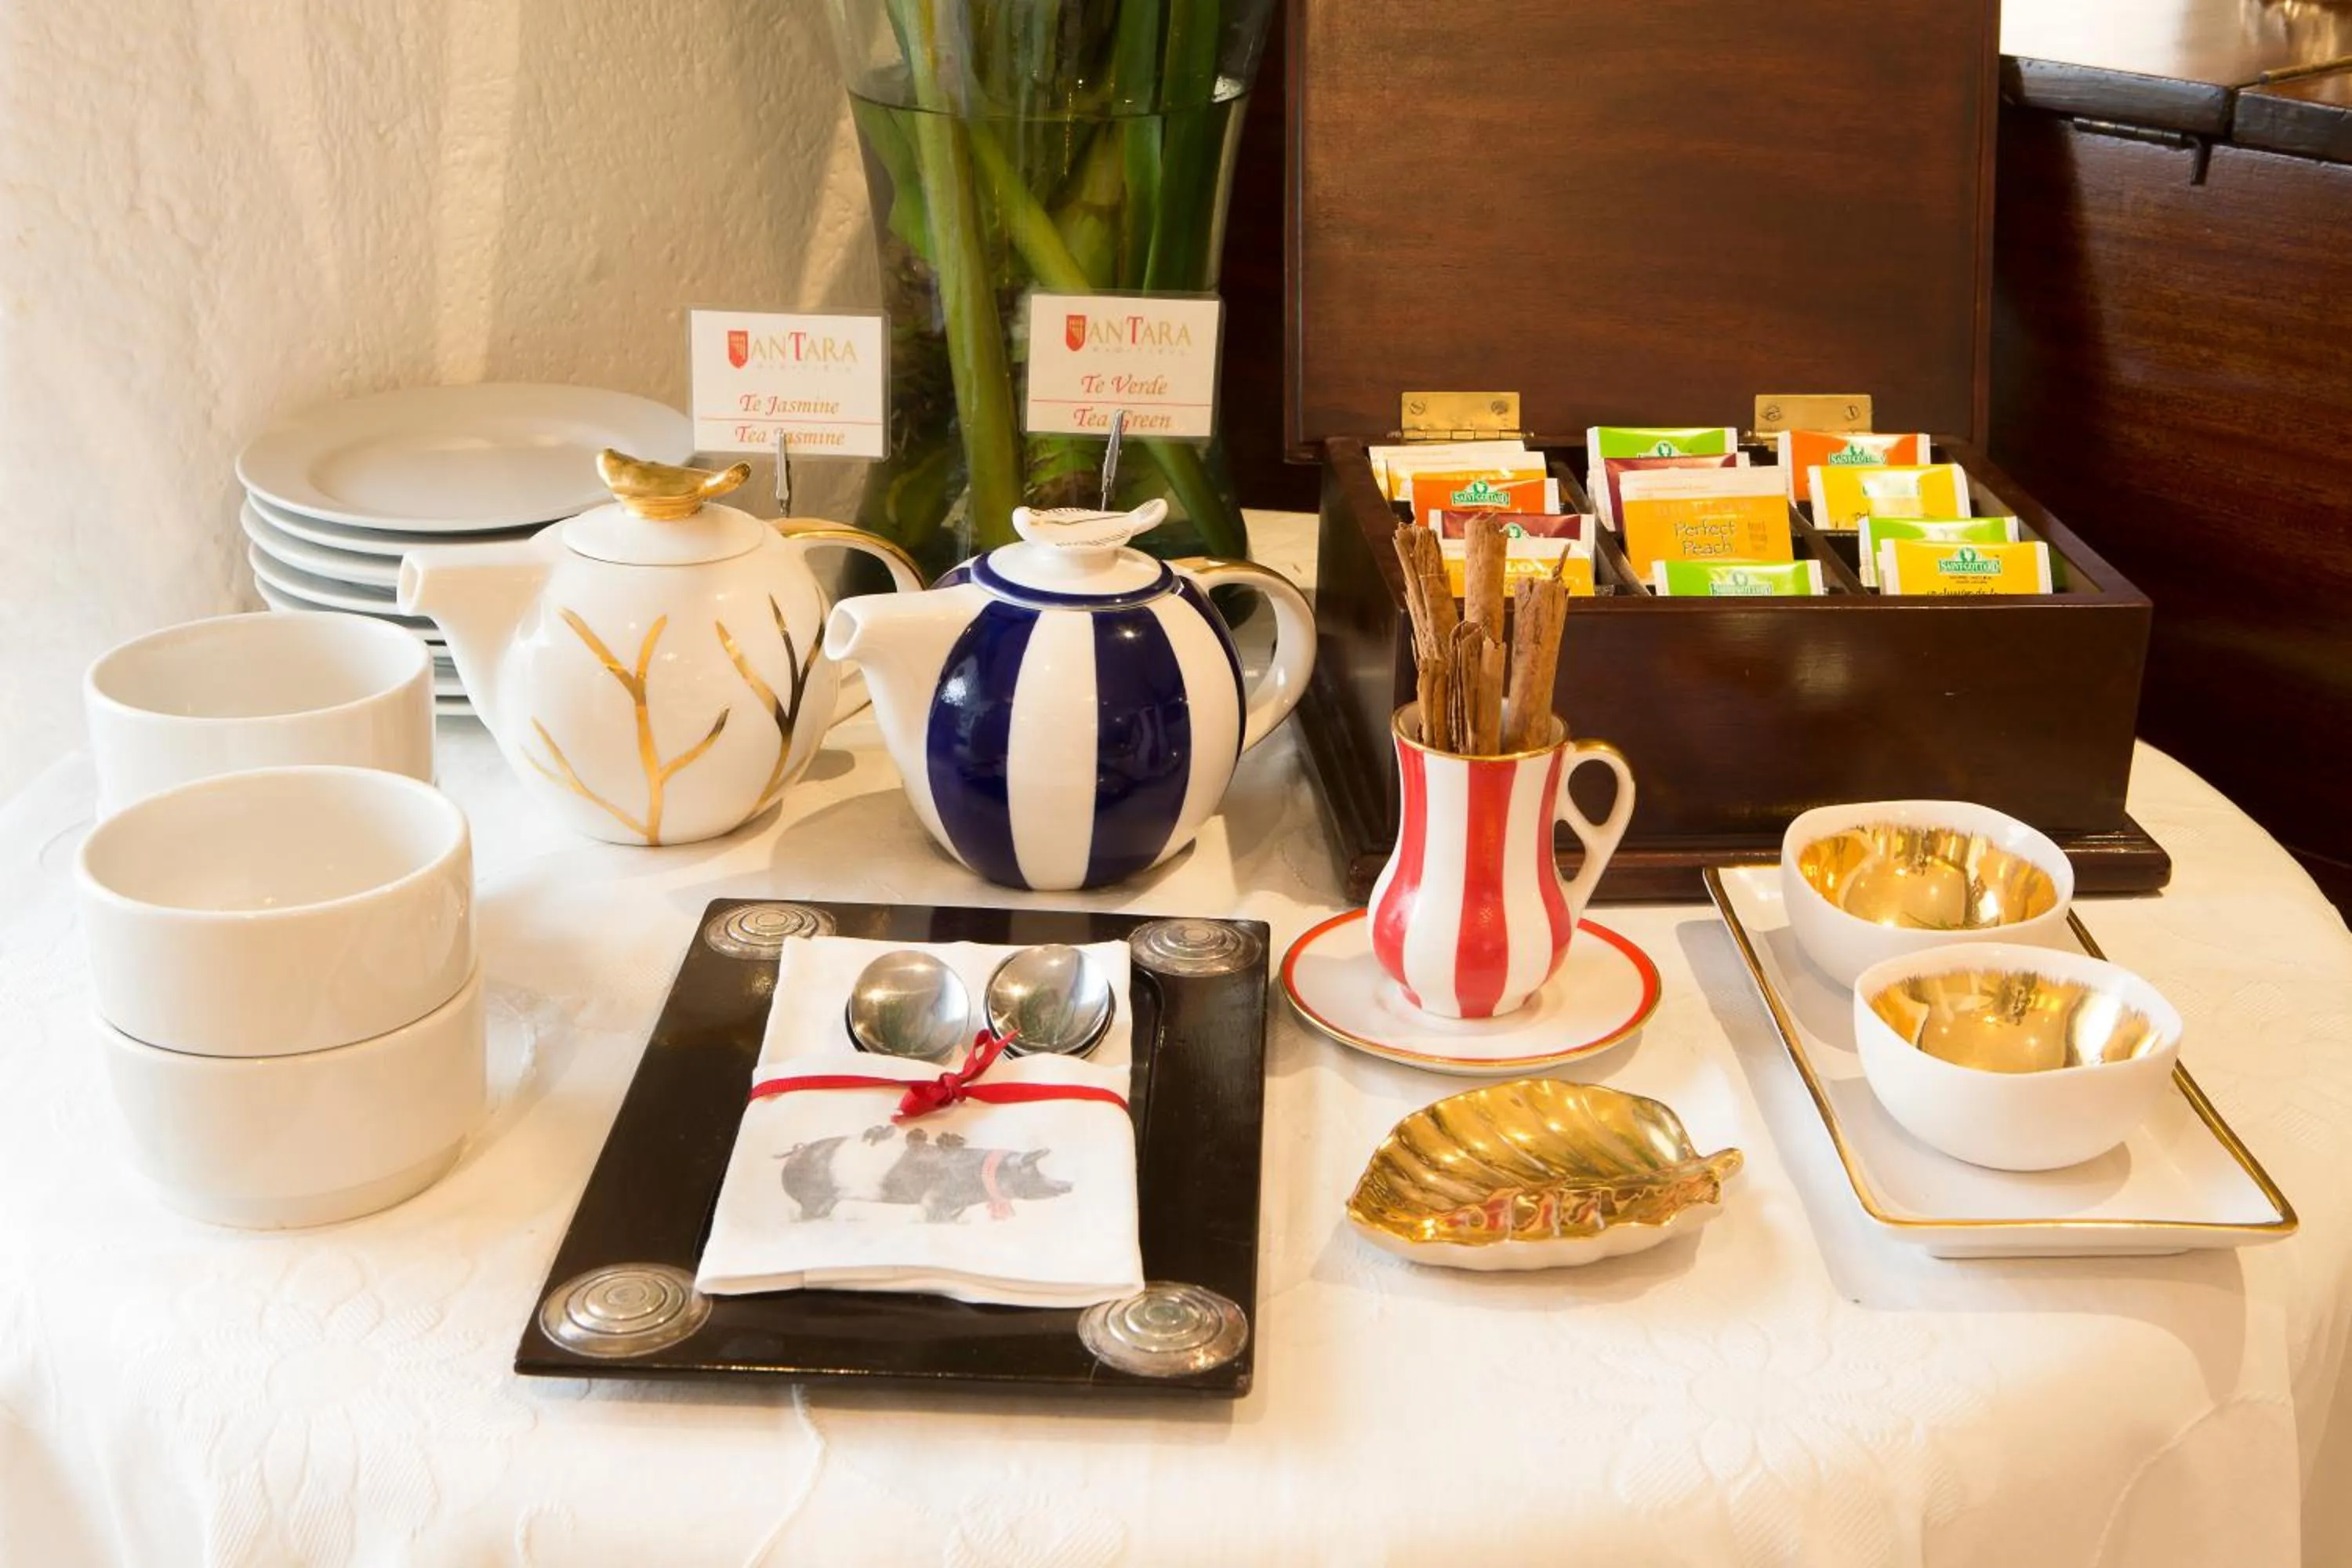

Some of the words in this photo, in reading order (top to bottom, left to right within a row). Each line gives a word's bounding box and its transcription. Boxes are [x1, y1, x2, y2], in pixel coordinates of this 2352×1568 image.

[1081, 375, 1105, 394] Te
[1111, 373, 1167, 395] Verde
[739, 394, 760, 412] Te
[765, 395, 839, 416] Jasmine
[1073, 406, 1108, 427] Tea
[735, 425, 766, 444] Tea
